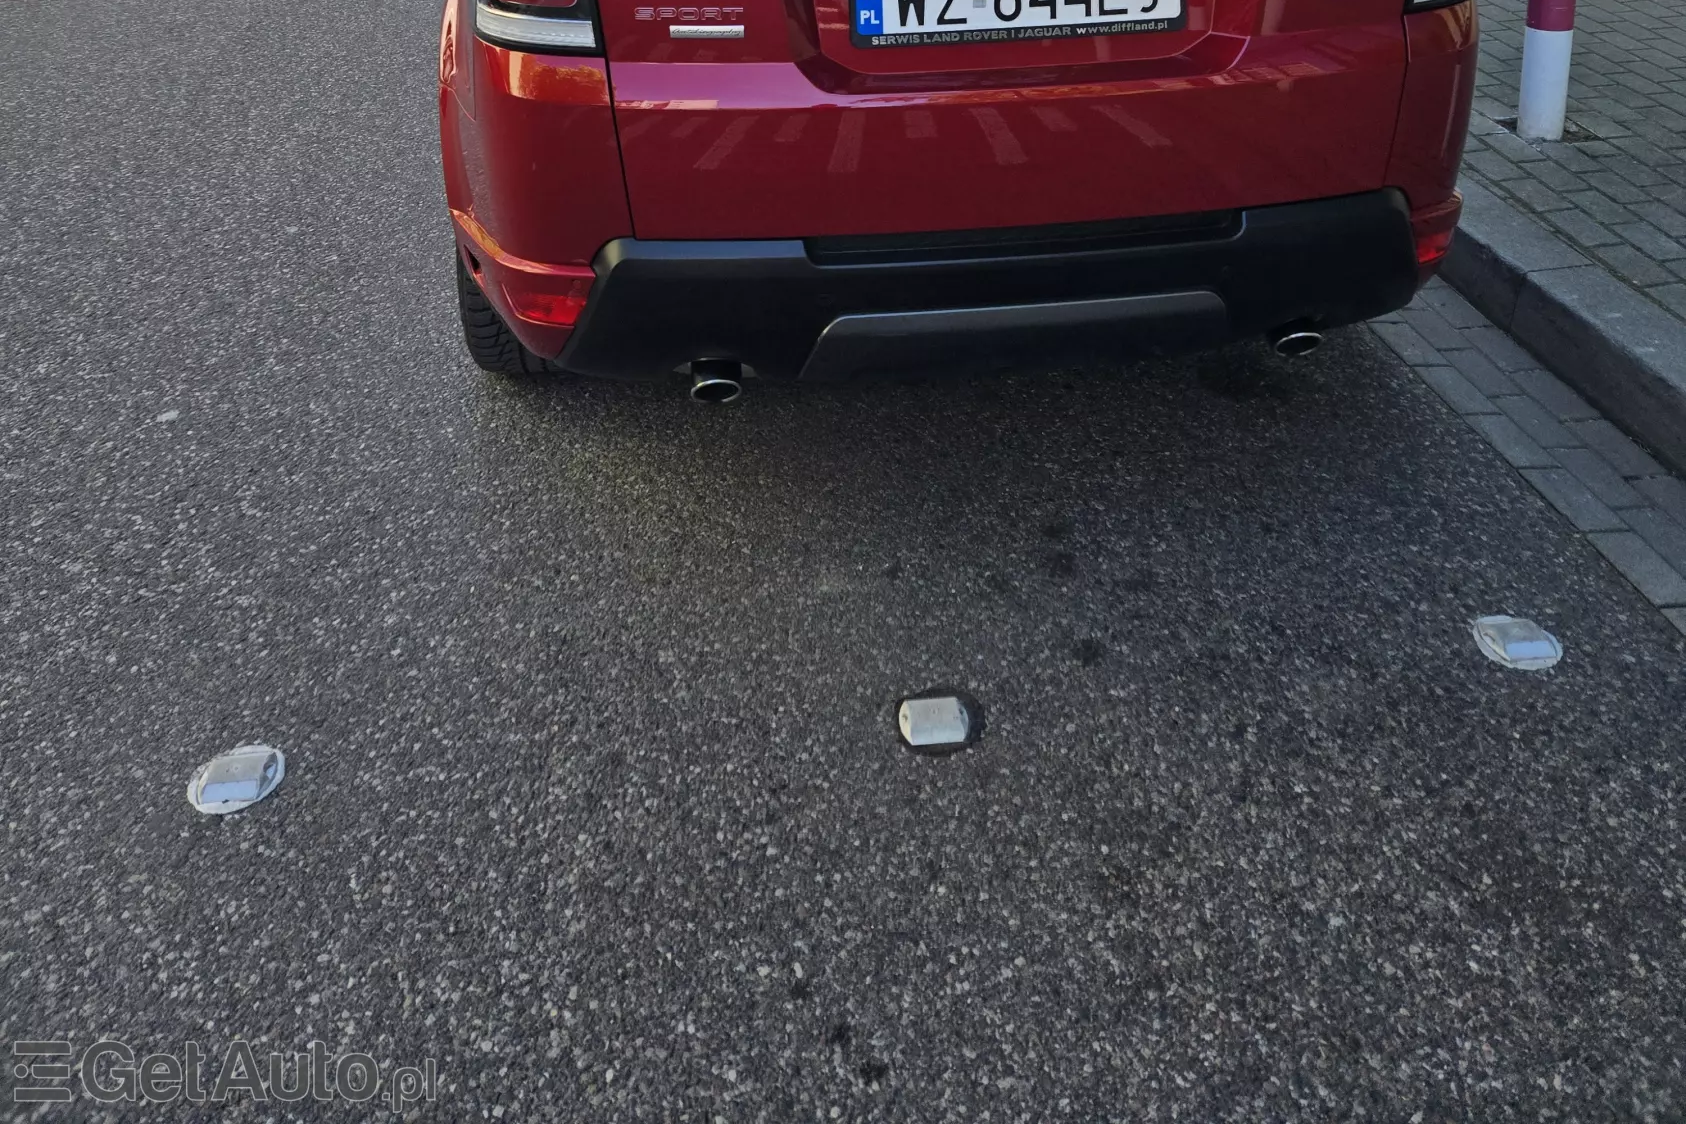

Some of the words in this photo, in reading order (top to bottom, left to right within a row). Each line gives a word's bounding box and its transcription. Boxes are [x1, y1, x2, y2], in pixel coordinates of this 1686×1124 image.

[634, 7, 744, 21] SPORT
[860, 9, 880, 25] PL
[871, 34, 920, 46] SERWIS
[923, 32, 960, 44] LAND
[963, 30, 1008, 42] ROVER
[1018, 26, 1071, 38] JAGUAR
[1076, 20, 1168, 35] www.diffland.pl
